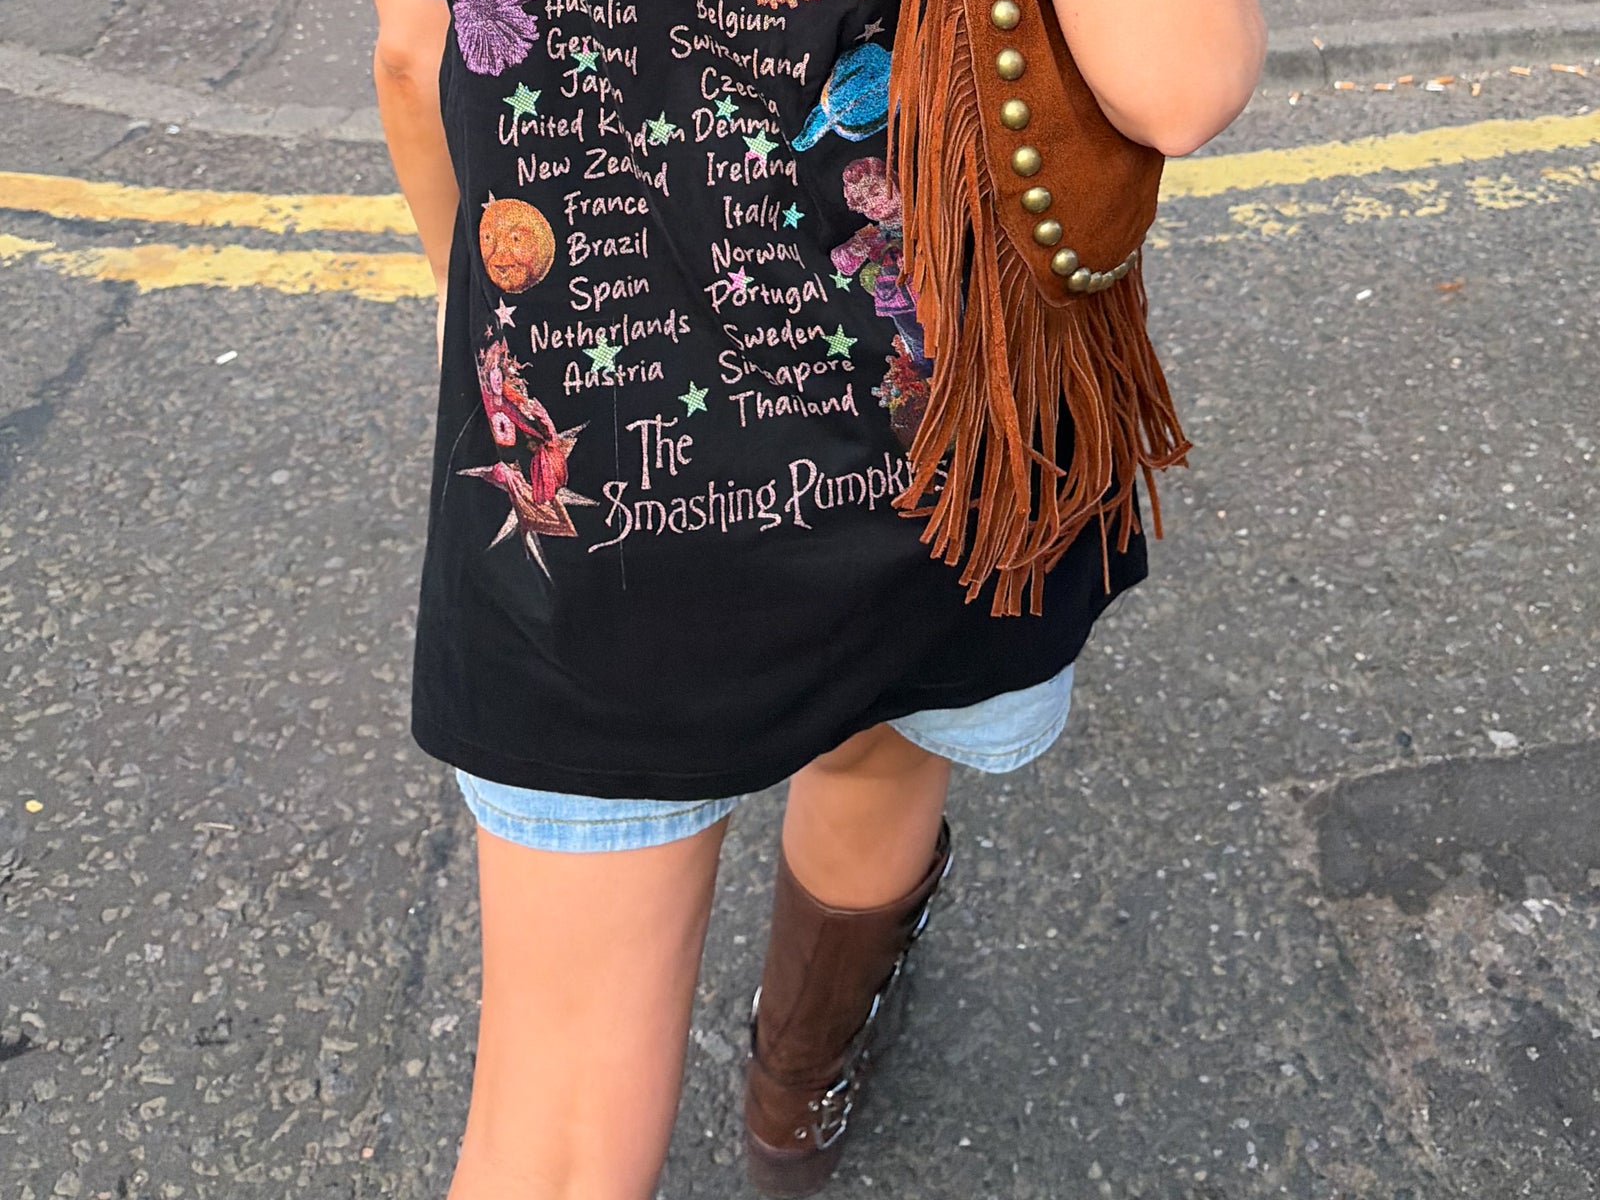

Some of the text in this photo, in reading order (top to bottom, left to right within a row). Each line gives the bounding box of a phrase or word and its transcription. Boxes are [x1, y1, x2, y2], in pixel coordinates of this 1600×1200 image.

[669, 24, 811, 87] Switzerland
[560, 68, 624, 104] Japn
[498, 107, 585, 147] United
[516, 153, 571, 187] New
[706, 151, 799, 187] Ireland
[563, 190, 650, 226] France
[722, 194, 781, 232] Italy
[566, 226, 649, 267] Brazil
[710, 238, 807, 275] Norway
[568, 275, 650, 312] Spain
[703, 272, 829, 315] Portugal
[530, 308, 692, 354] Netherlands
[722, 318, 826, 351] Sweden
[562, 360, 664, 396] Austria
[728, 382, 860, 428] Thailand
[625, 413, 693, 491] The
[587, 479, 782, 554] Smashing
